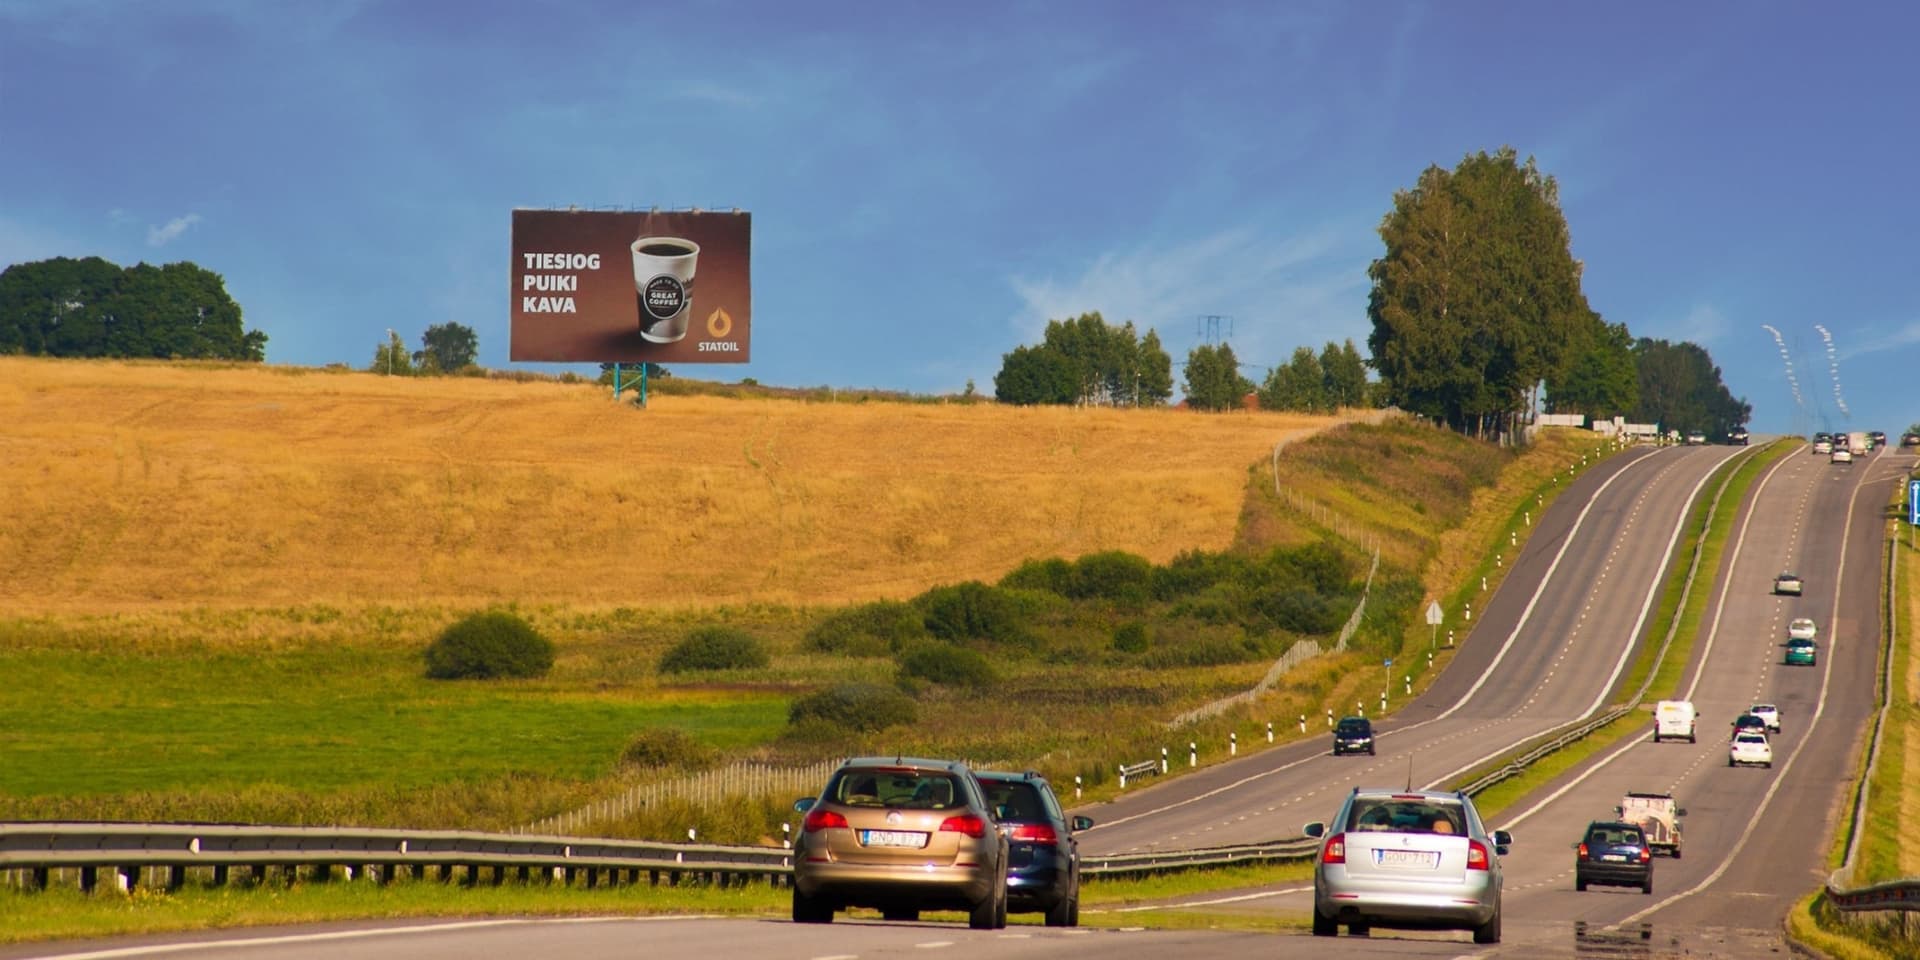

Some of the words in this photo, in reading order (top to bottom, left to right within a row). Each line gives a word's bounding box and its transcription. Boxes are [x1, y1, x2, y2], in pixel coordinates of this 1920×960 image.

[523, 253, 601, 270] TIESIOG
[523, 274, 578, 292] PUIKI
[522, 296, 577, 313] KAVA
[649, 298, 679, 306] COFFEE
[698, 341, 739, 352] STATOIL
